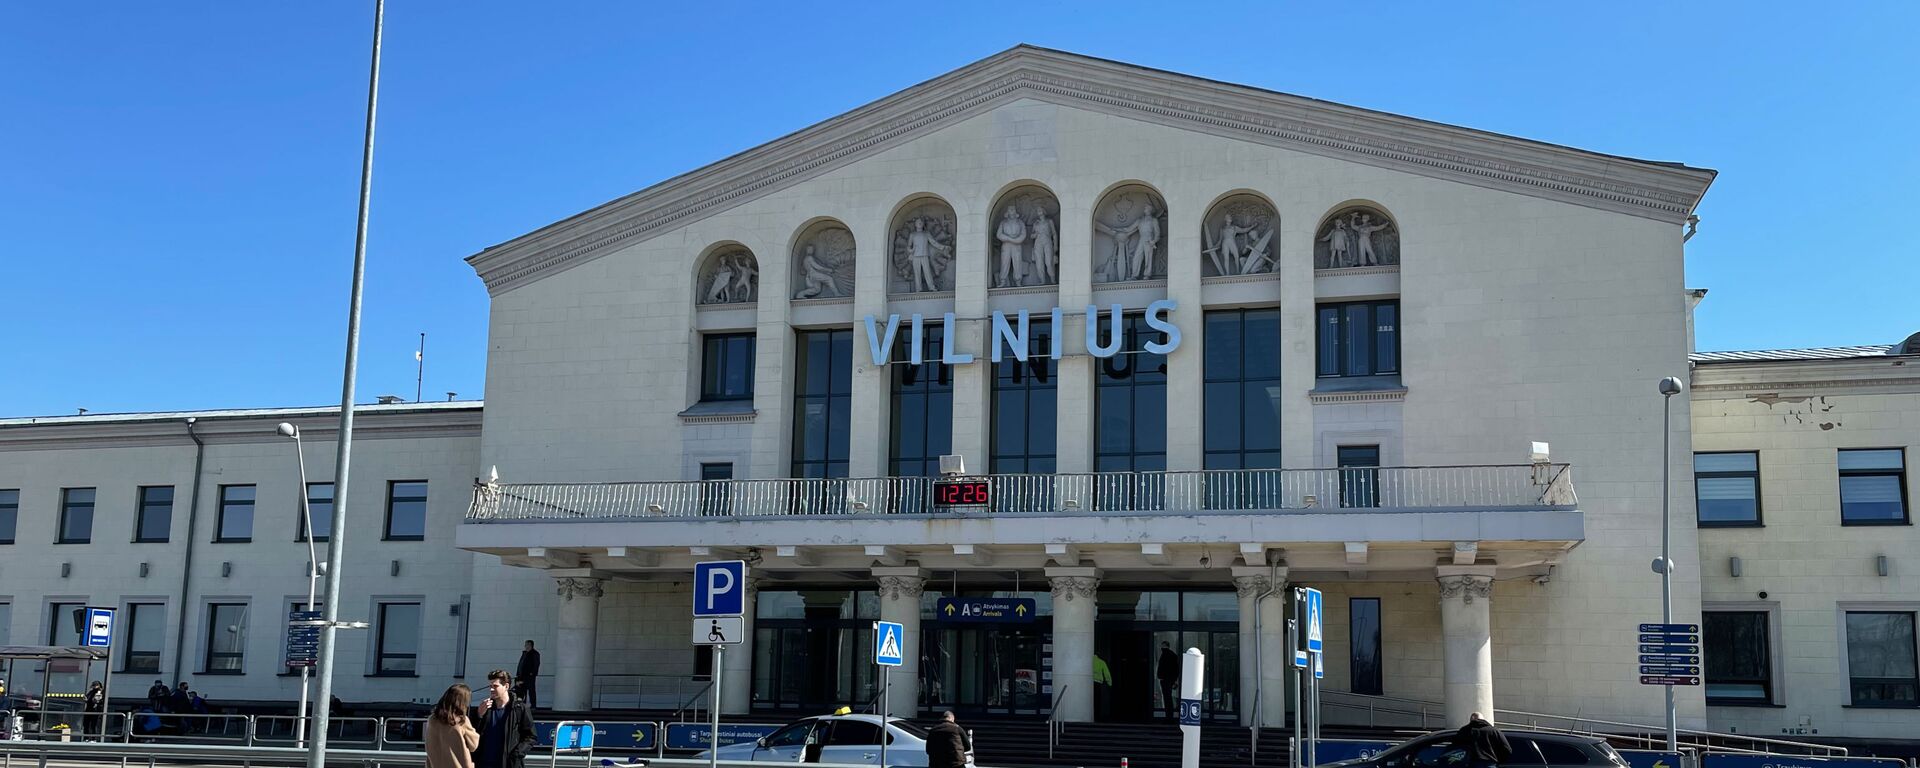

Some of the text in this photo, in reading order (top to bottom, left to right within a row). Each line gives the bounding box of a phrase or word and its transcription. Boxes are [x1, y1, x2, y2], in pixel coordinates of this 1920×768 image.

[864, 300, 1182, 366] VILNIUS
[707, 567, 734, 609] P
[961, 603, 971, 616] A
